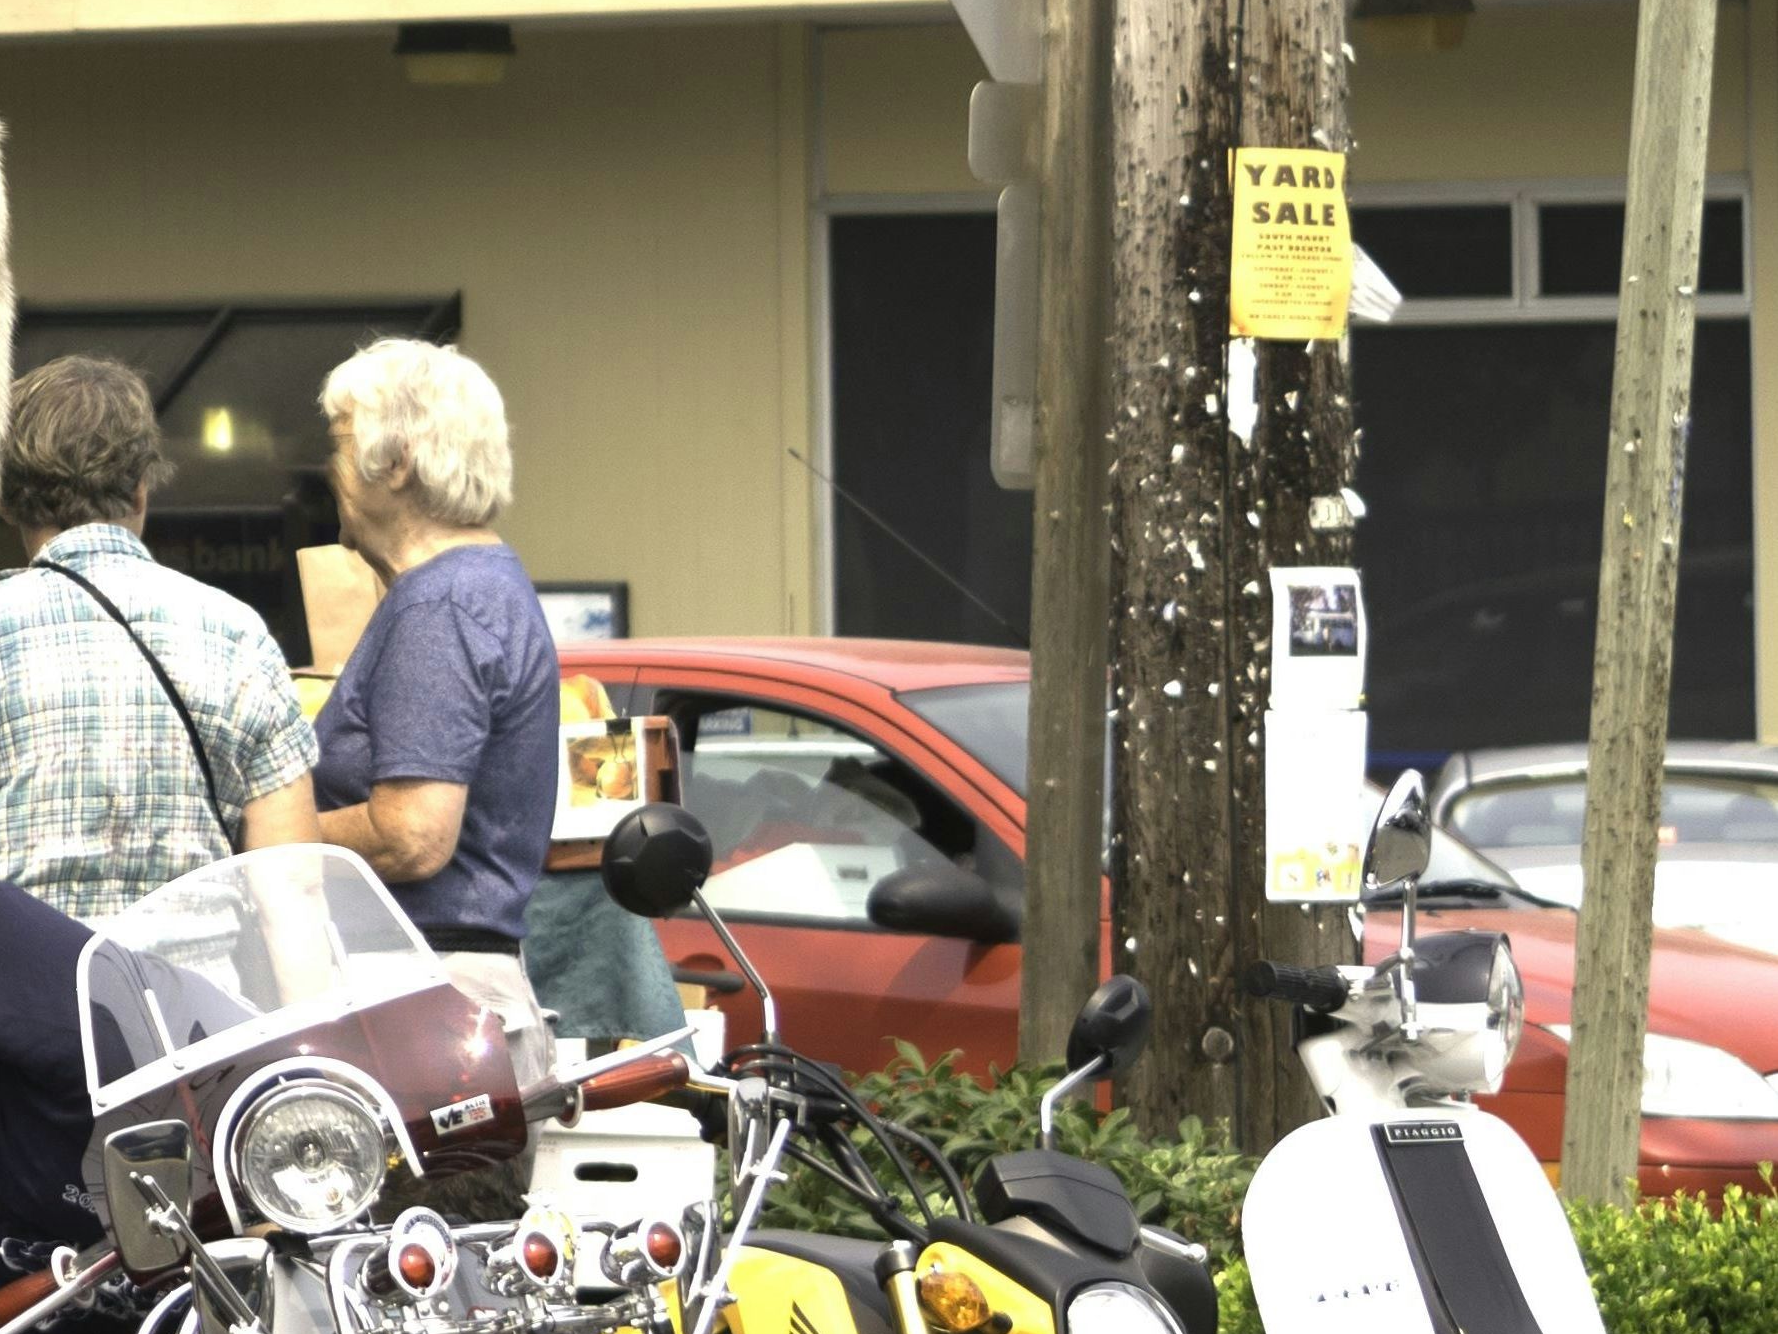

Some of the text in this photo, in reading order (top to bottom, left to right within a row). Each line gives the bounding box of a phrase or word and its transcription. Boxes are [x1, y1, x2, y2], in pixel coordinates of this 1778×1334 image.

[1244, 164, 1335, 189] YARD
[1252, 202, 1335, 226] SALE
[1394, 1126, 1456, 1137] PIAGGIO
